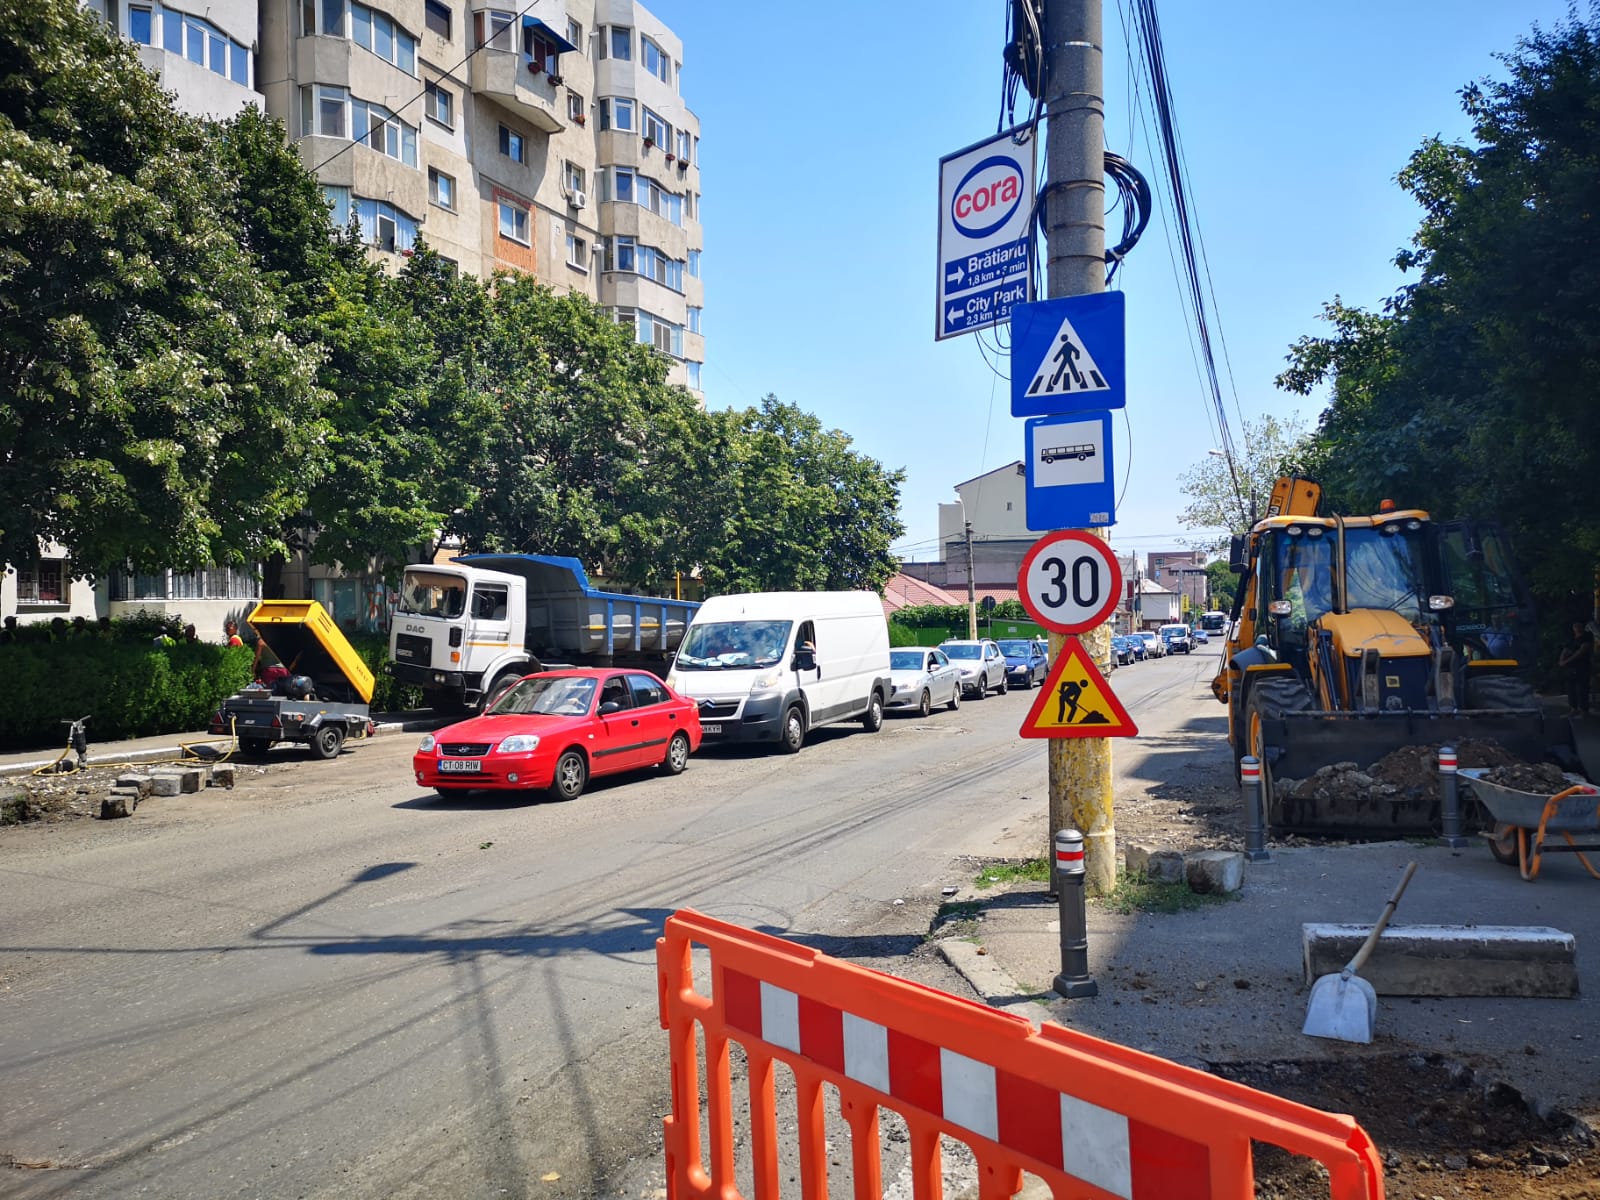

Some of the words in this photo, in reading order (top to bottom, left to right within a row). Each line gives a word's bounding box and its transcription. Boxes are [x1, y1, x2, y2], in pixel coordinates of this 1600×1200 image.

[955, 175, 1017, 219] cora
[968, 275, 979, 286] 1,8
[981, 271, 994, 281] km
[1009, 261, 1025, 273] min
[967, 297, 991, 313] City
[994, 285, 1024, 306] Park
[966, 314, 978, 326] 2,3
[979, 310, 993, 321] km
[1041, 556, 1099, 608] 30
[406, 624, 425, 633] DAC
